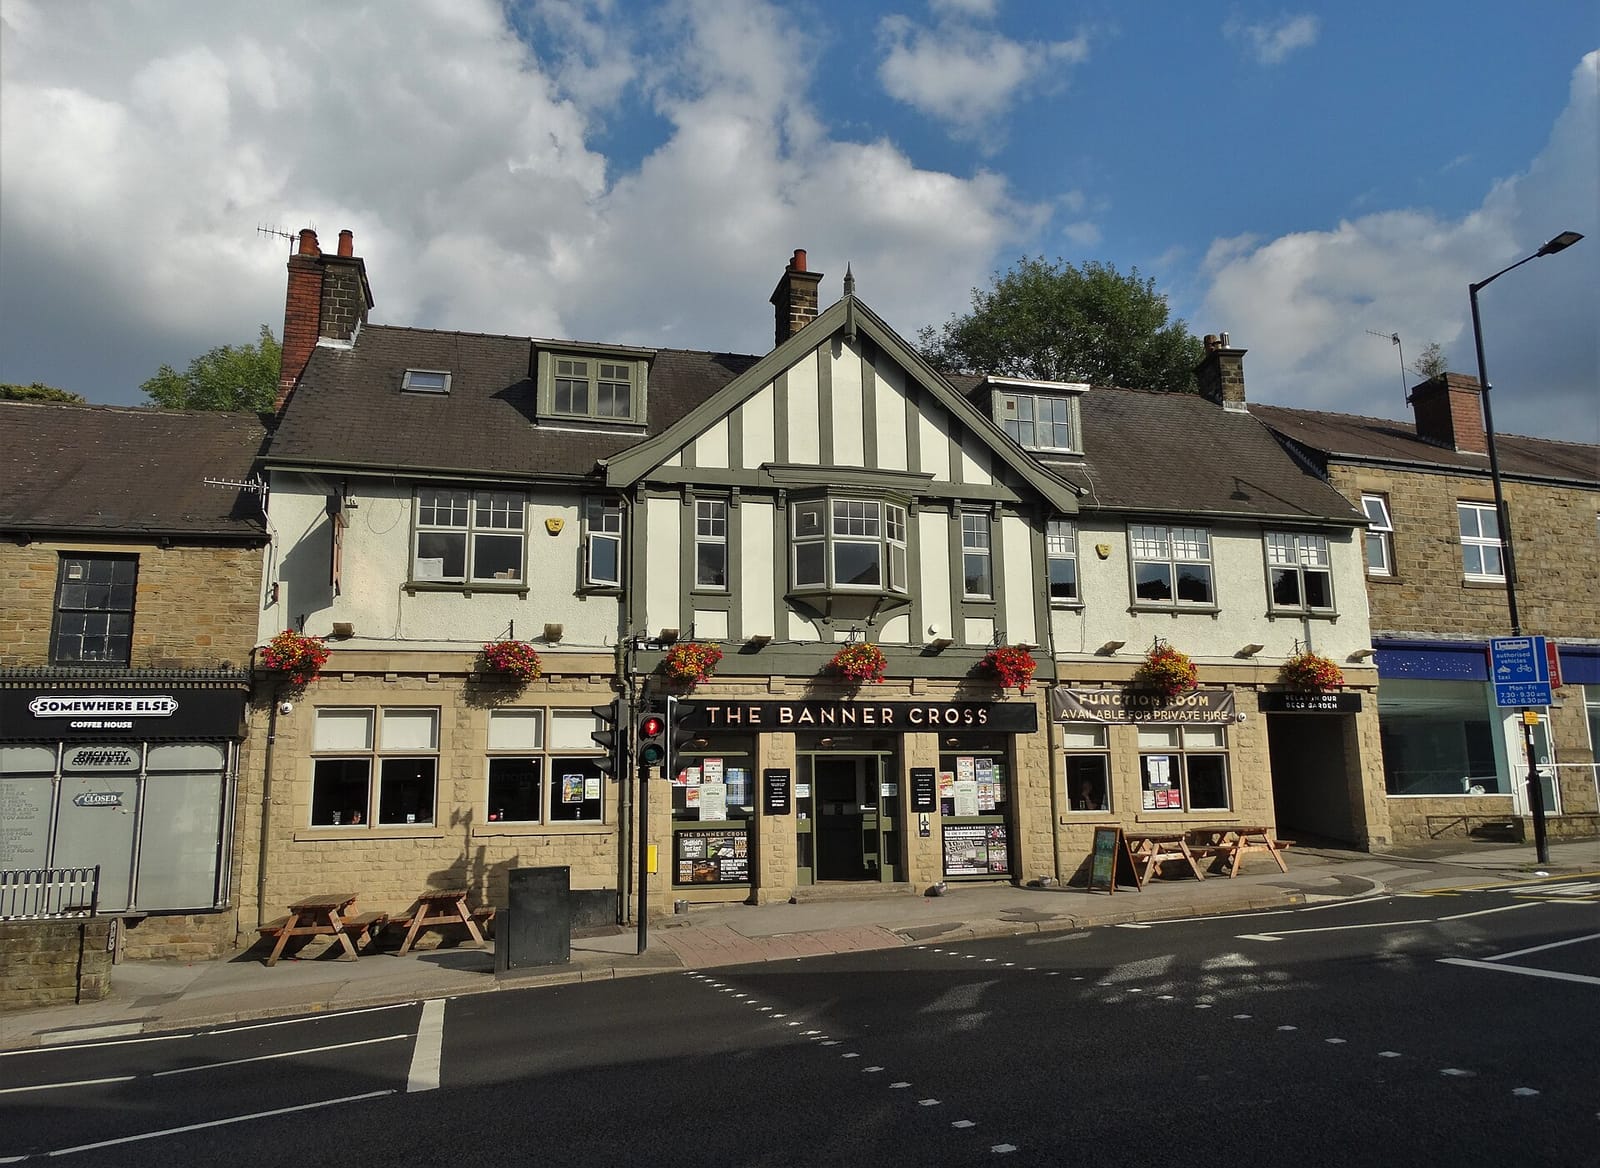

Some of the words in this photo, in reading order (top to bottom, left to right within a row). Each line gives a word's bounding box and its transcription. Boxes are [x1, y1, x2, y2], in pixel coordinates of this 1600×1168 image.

[1079, 694, 1160, 706] FUNCTION
[39, 701, 132, 711] SOMEWHERE
[136, 701, 169, 711] ELSE
[706, 707, 761, 723] THE
[779, 707, 894, 724] BANNER
[909, 708, 987, 724] CROSS
[1061, 709, 1125, 720] AVAILABLE
[1128, 709, 1151, 720] FOR
[1154, 709, 1200, 720] PRIVATE
[1203, 709, 1229, 720] HIRE
